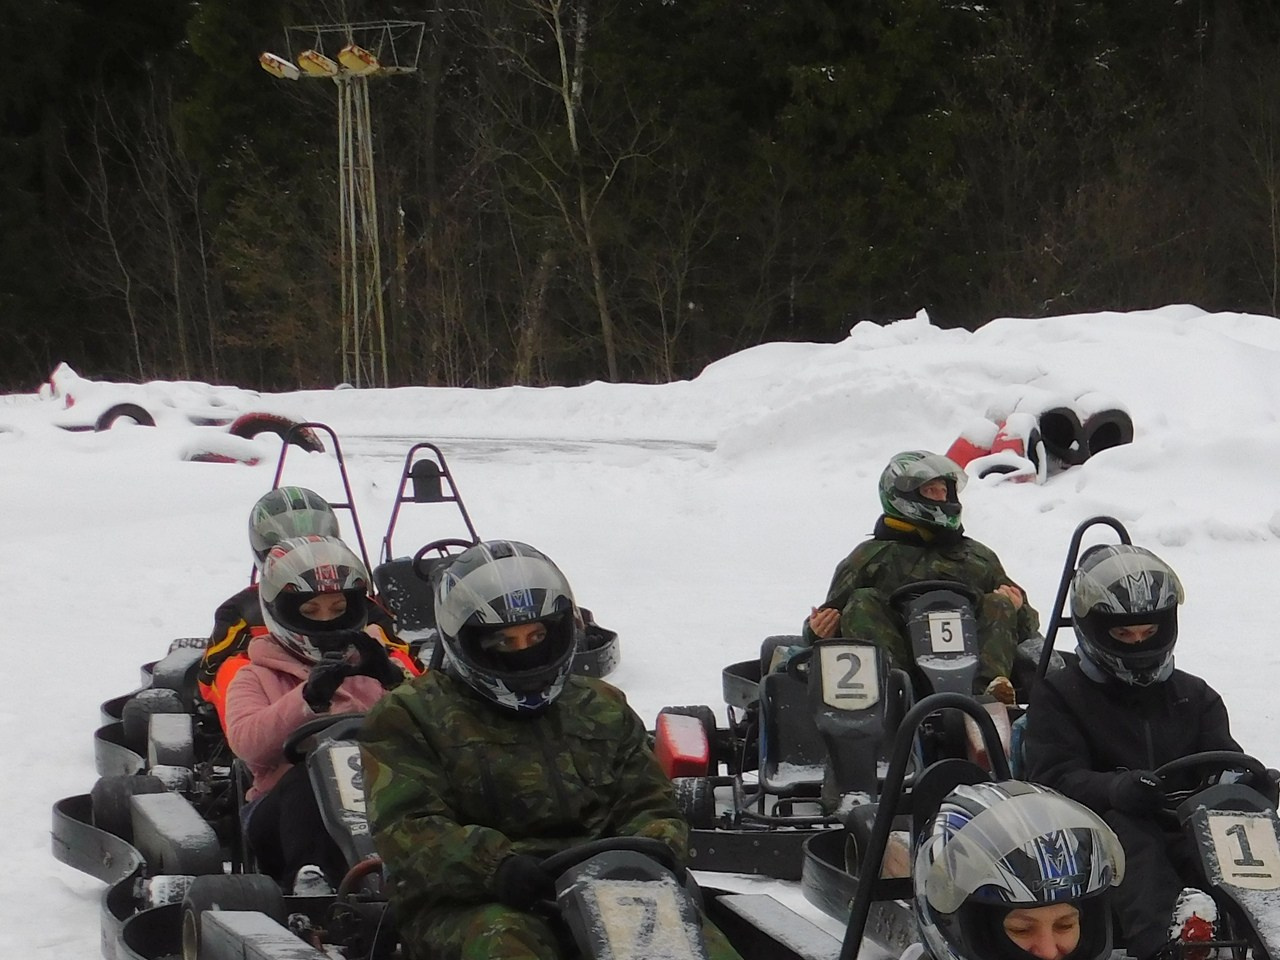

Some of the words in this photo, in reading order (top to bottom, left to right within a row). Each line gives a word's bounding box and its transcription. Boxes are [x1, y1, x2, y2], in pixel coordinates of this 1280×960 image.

[941, 621, 953, 643] 5
[836, 652, 864, 689] 2
[1225, 824, 1265, 866] 1
[616, 896, 657, 947] 7
